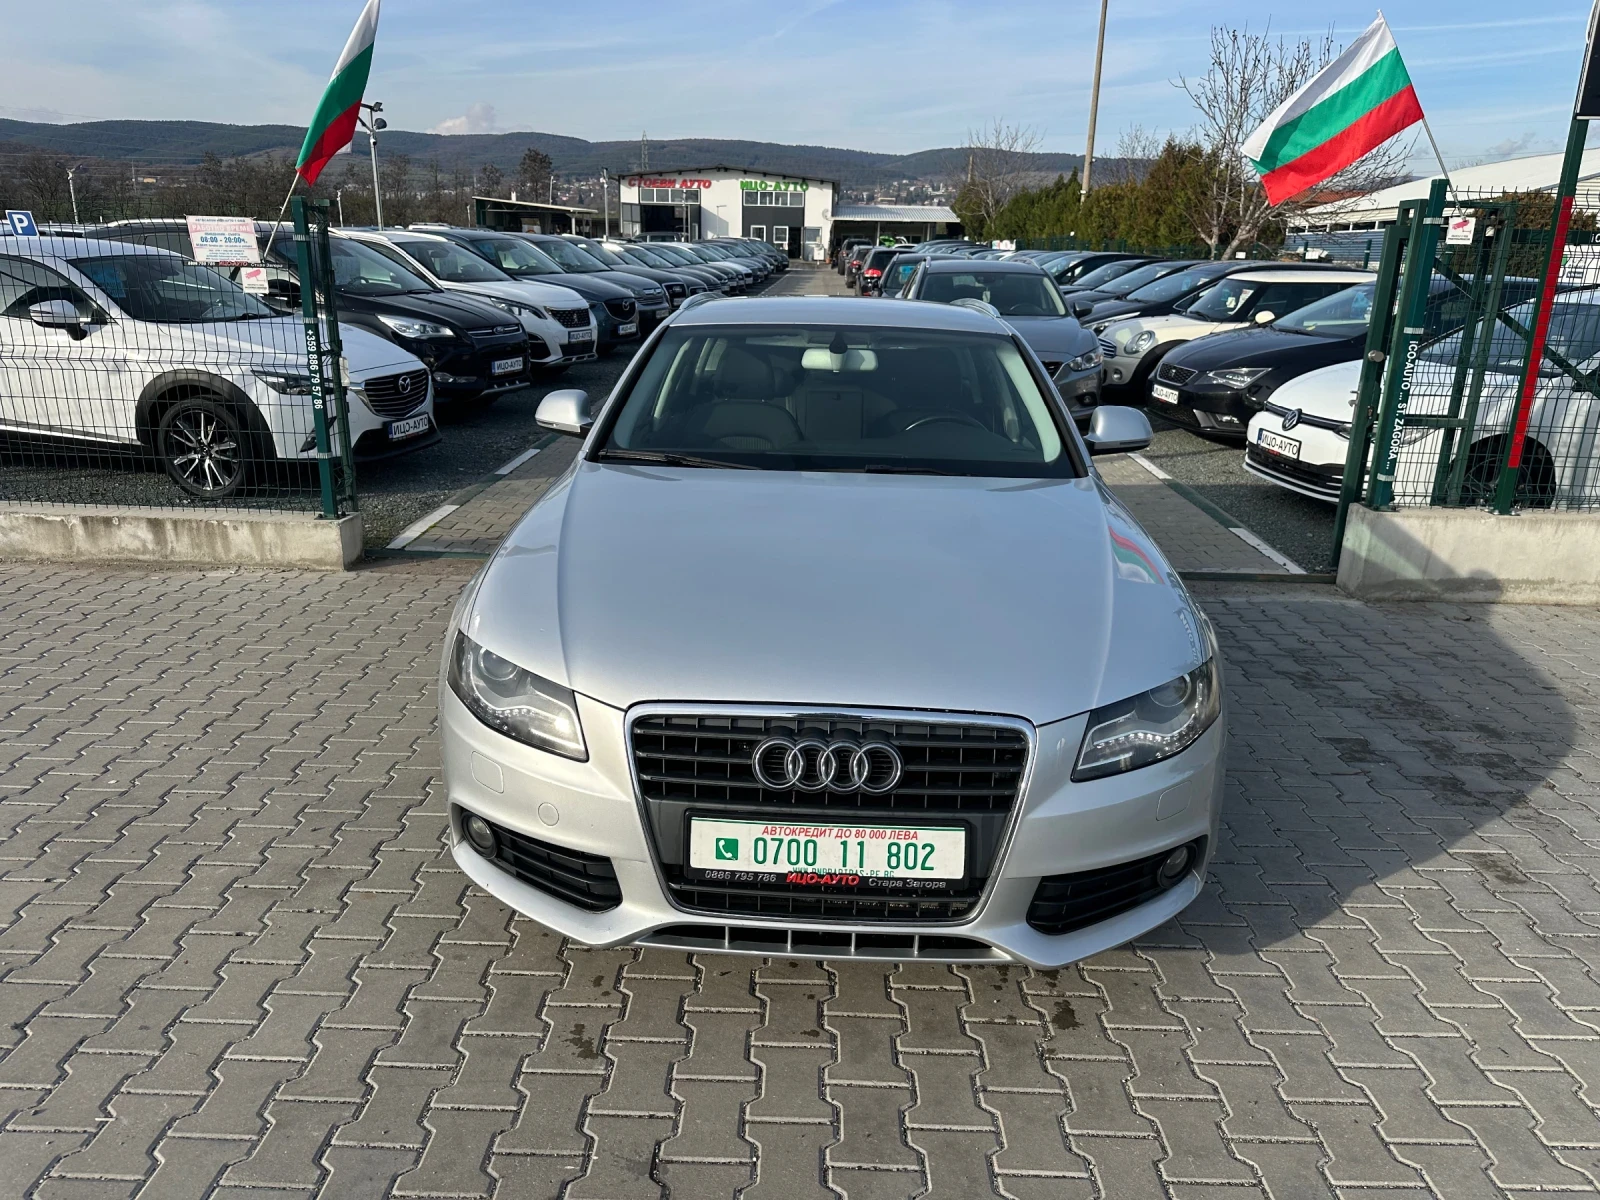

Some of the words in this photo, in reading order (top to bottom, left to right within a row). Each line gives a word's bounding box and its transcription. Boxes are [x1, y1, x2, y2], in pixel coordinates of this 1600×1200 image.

[628, 177, 676, 189] СТОЕВИ
[680, 179, 712, 189] АУТО
[740, 180, 810, 192] ИЦО-АУТО
[11, 213, 29, 234] P
[306, 329, 317, 352] +359
[308, 353, 319, 371] 886
[496, 359, 522, 373] ИЦО-АУТО
[310, 372, 320, 384] 79
[312, 386, 322, 397] 57
[313, 399, 323, 410] 86
[393, 416, 428, 436] ИЦО-АУТО
[1261, 433, 1298, 456] ИЦО-АУТО
[1387, 418, 1405, 460] ZAGORA
[762, 826, 834, 838] АВТОКРЕДИТ
[834, 828, 852, 839] ДО
[854, 829, 866, 839] 80
[869, 829, 887, 840] 000
[888, 830, 918, 840] ЛЕВА
[753, 837, 818, 866] 0700
[840, 840, 865, 868] 11
[887, 841, 935, 871] 802
[704, 870, 731, 880] 0886
[734, 871, 754, 881] 795
[757, 873, 777, 882] 786
[786, 871, 859, 886] ИЦО-АУТО
[868, 878, 903, 888] Стара
[906, 878, 947, 889] Загора
